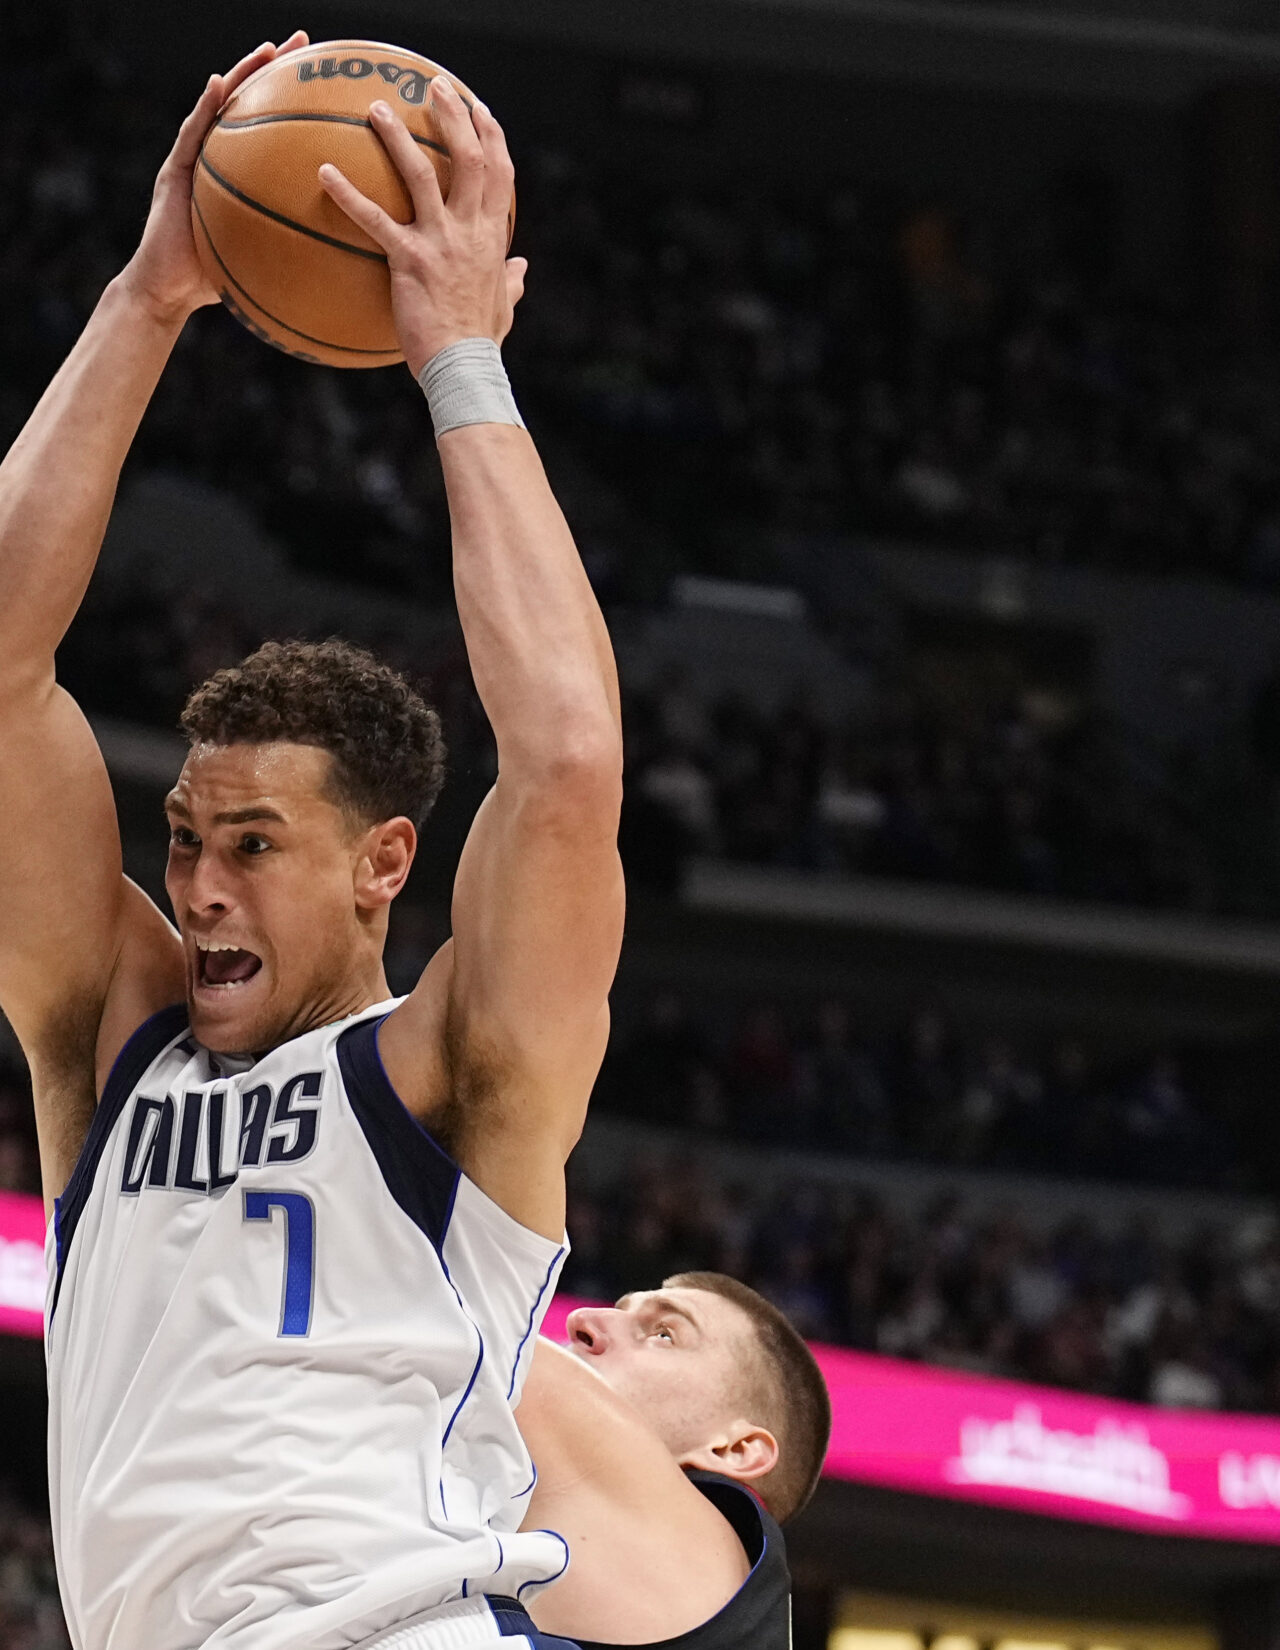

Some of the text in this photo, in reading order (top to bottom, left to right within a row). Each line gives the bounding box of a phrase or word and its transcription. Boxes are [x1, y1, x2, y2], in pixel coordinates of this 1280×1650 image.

[296, 57, 432, 107] lson
[119, 1069, 327, 1198] DALLAS
[242, 1187, 316, 1338] 7
